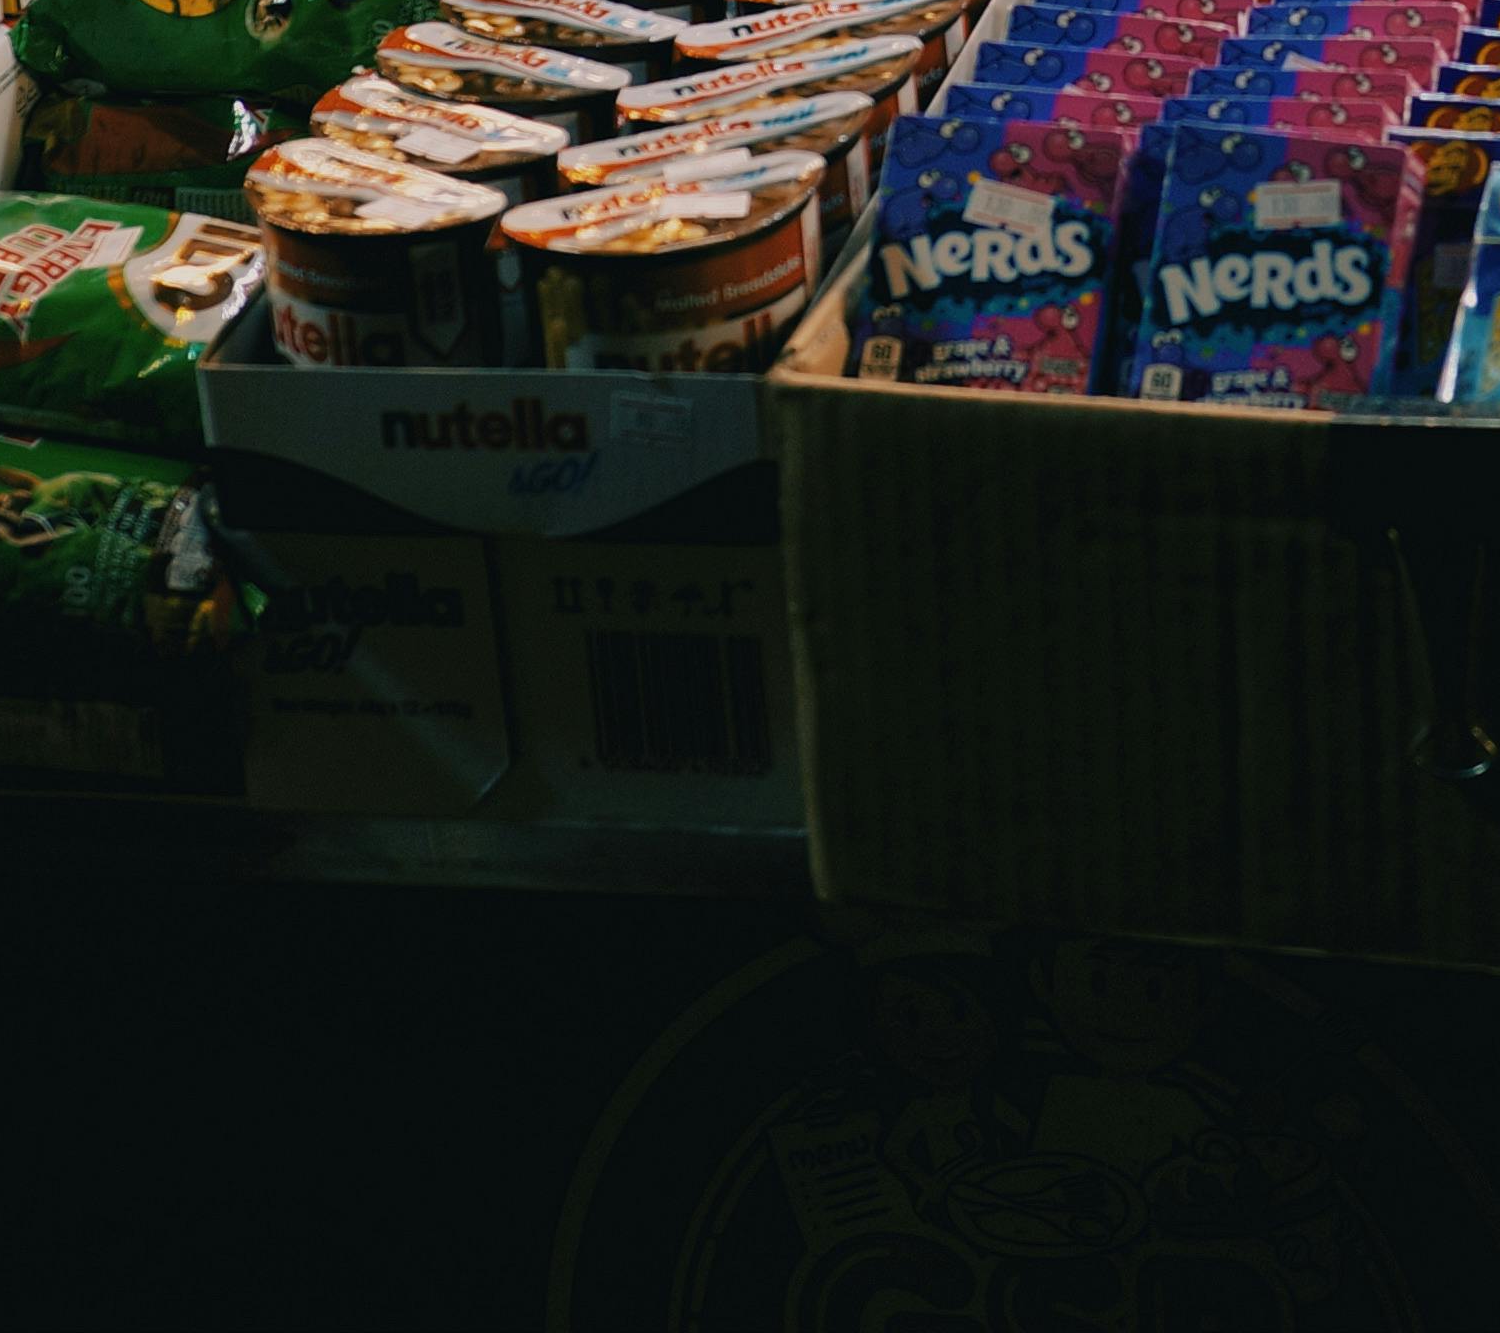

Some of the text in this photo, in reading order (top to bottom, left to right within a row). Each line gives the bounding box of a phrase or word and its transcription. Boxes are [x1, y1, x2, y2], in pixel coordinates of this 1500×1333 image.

[671, 57, 804, 99] nutella
[914, 357, 1029, 385] strawberry
[380, 400, 589, 453] nutella
[786, 1132, 875, 1174] menu
